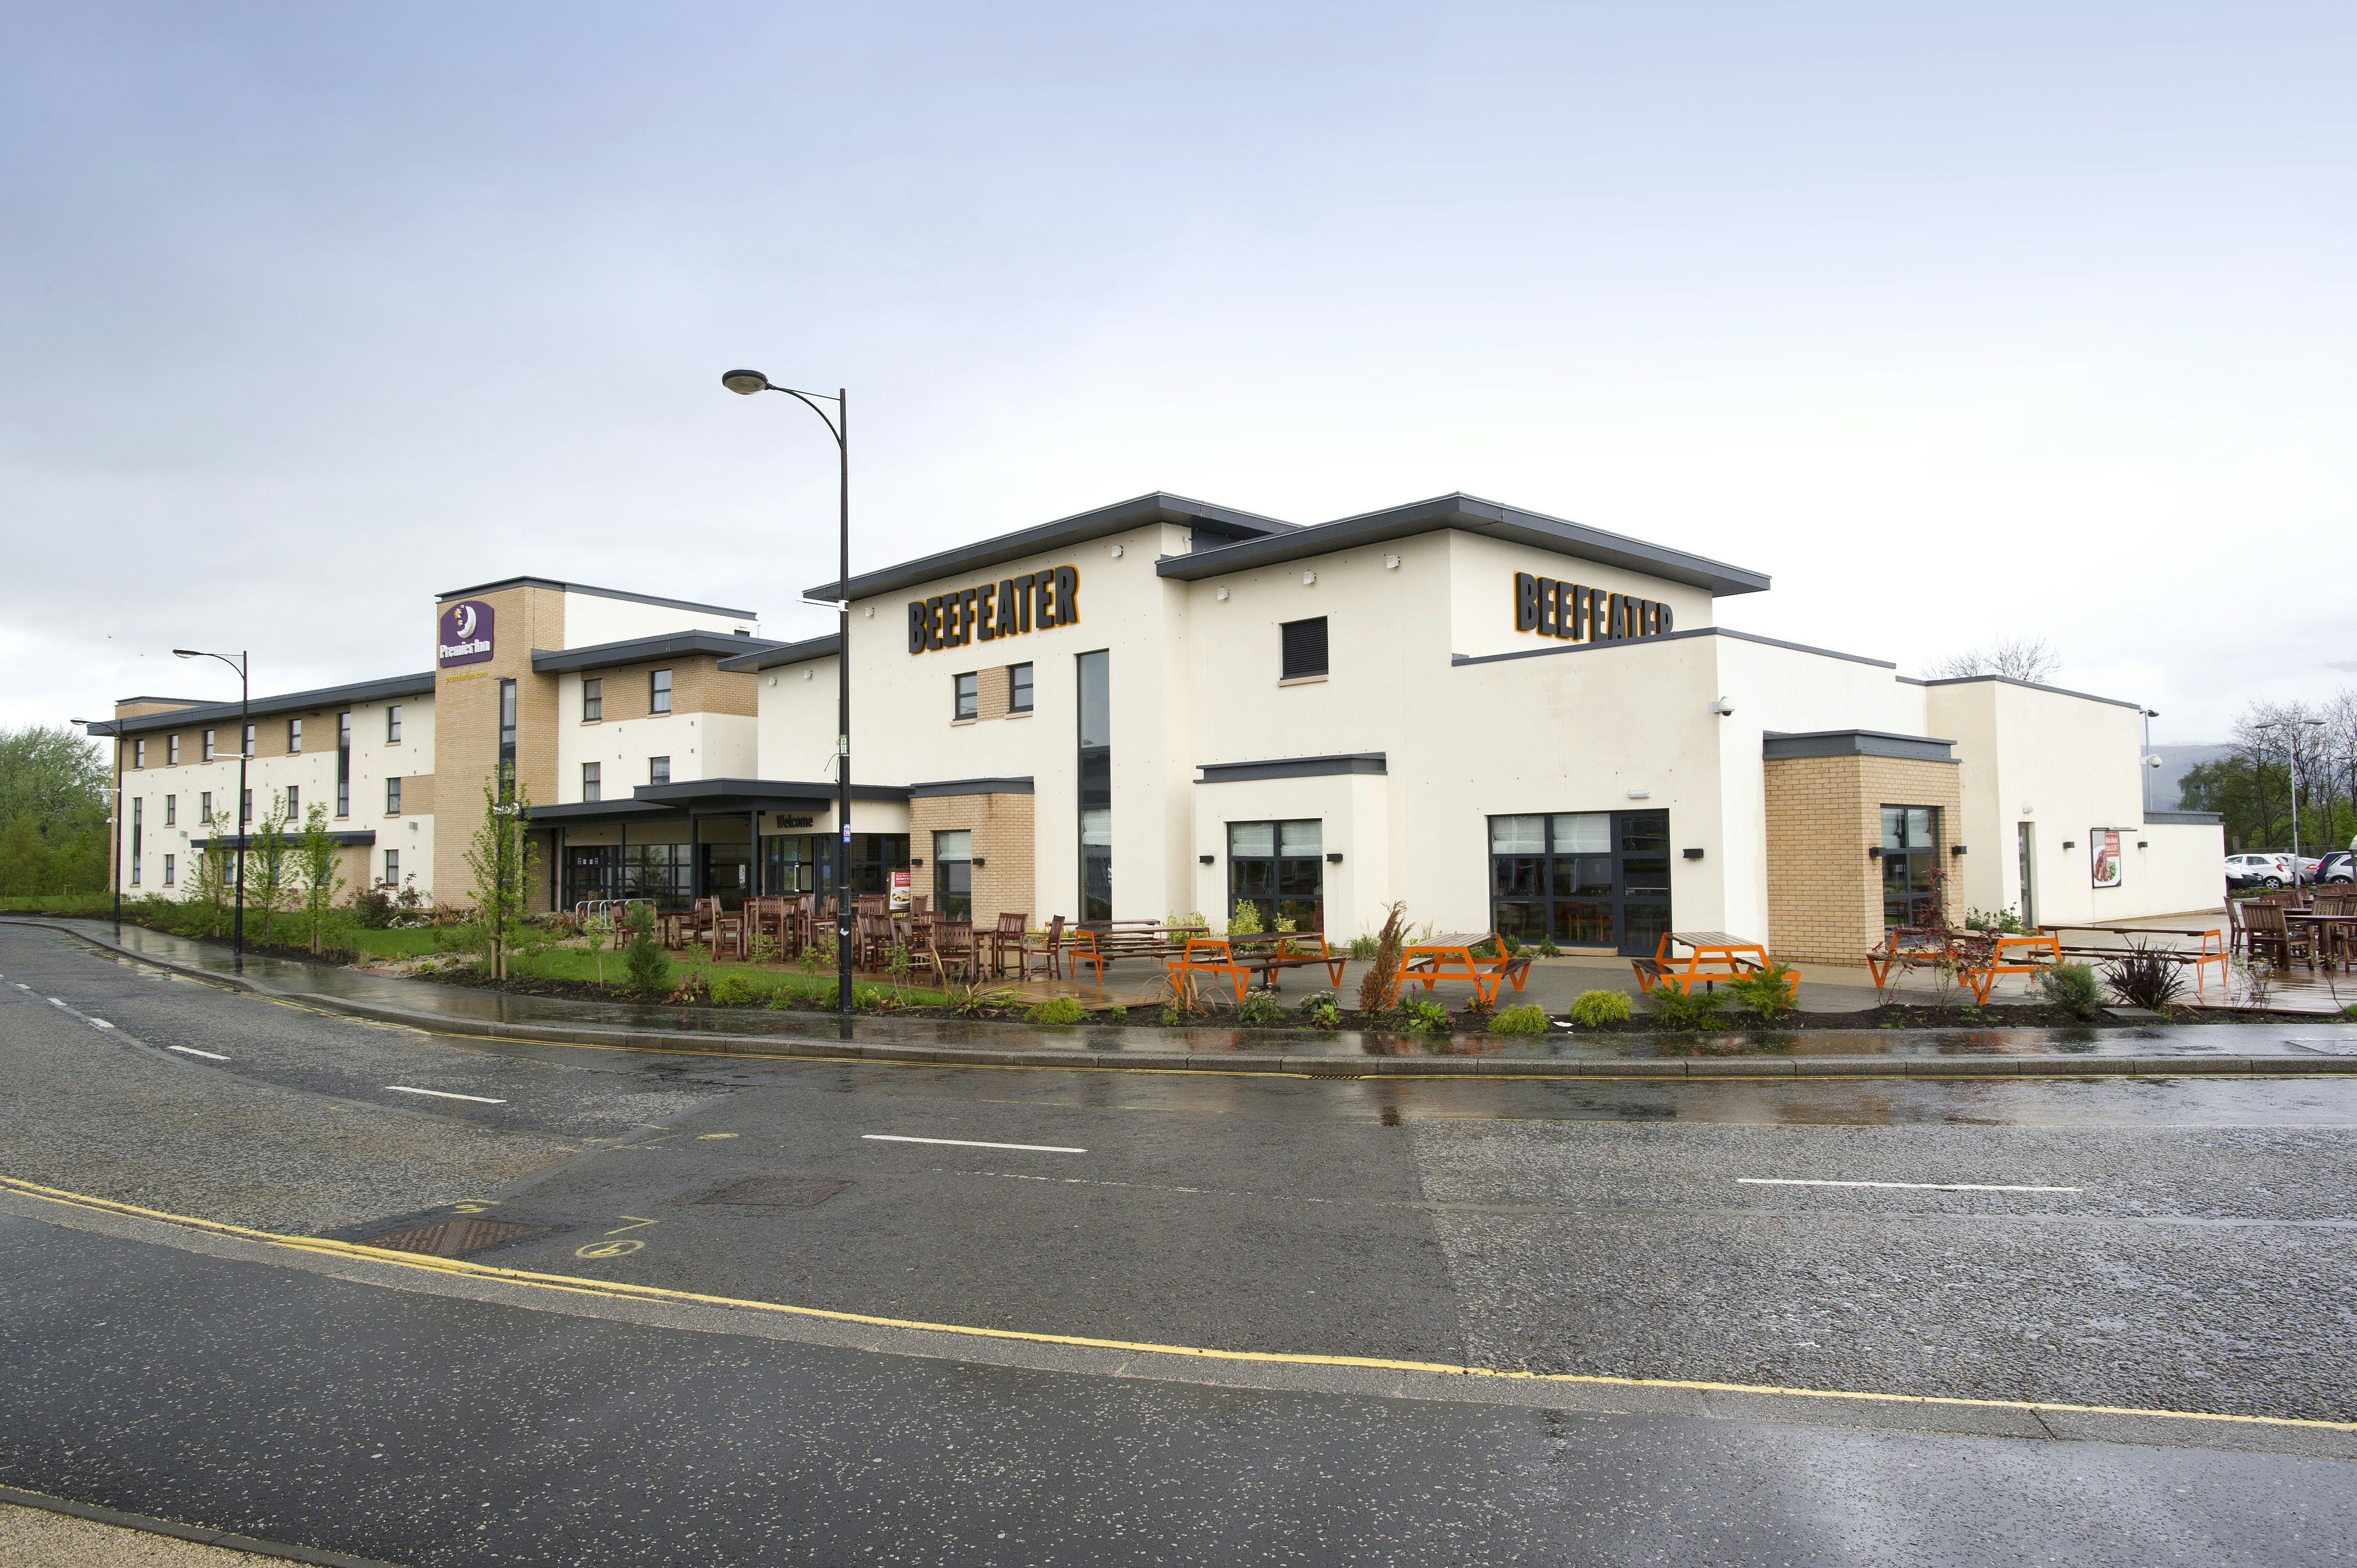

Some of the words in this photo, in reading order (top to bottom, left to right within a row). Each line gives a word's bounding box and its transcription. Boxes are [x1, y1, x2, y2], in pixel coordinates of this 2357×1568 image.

[908, 563, 1080, 656] BEEFEATER
[440, 642, 474, 658] Premier
[475, 639, 490, 653] Inn
[445, 671, 487, 685] premierinn.com
[776, 814, 814, 828] Welcome
